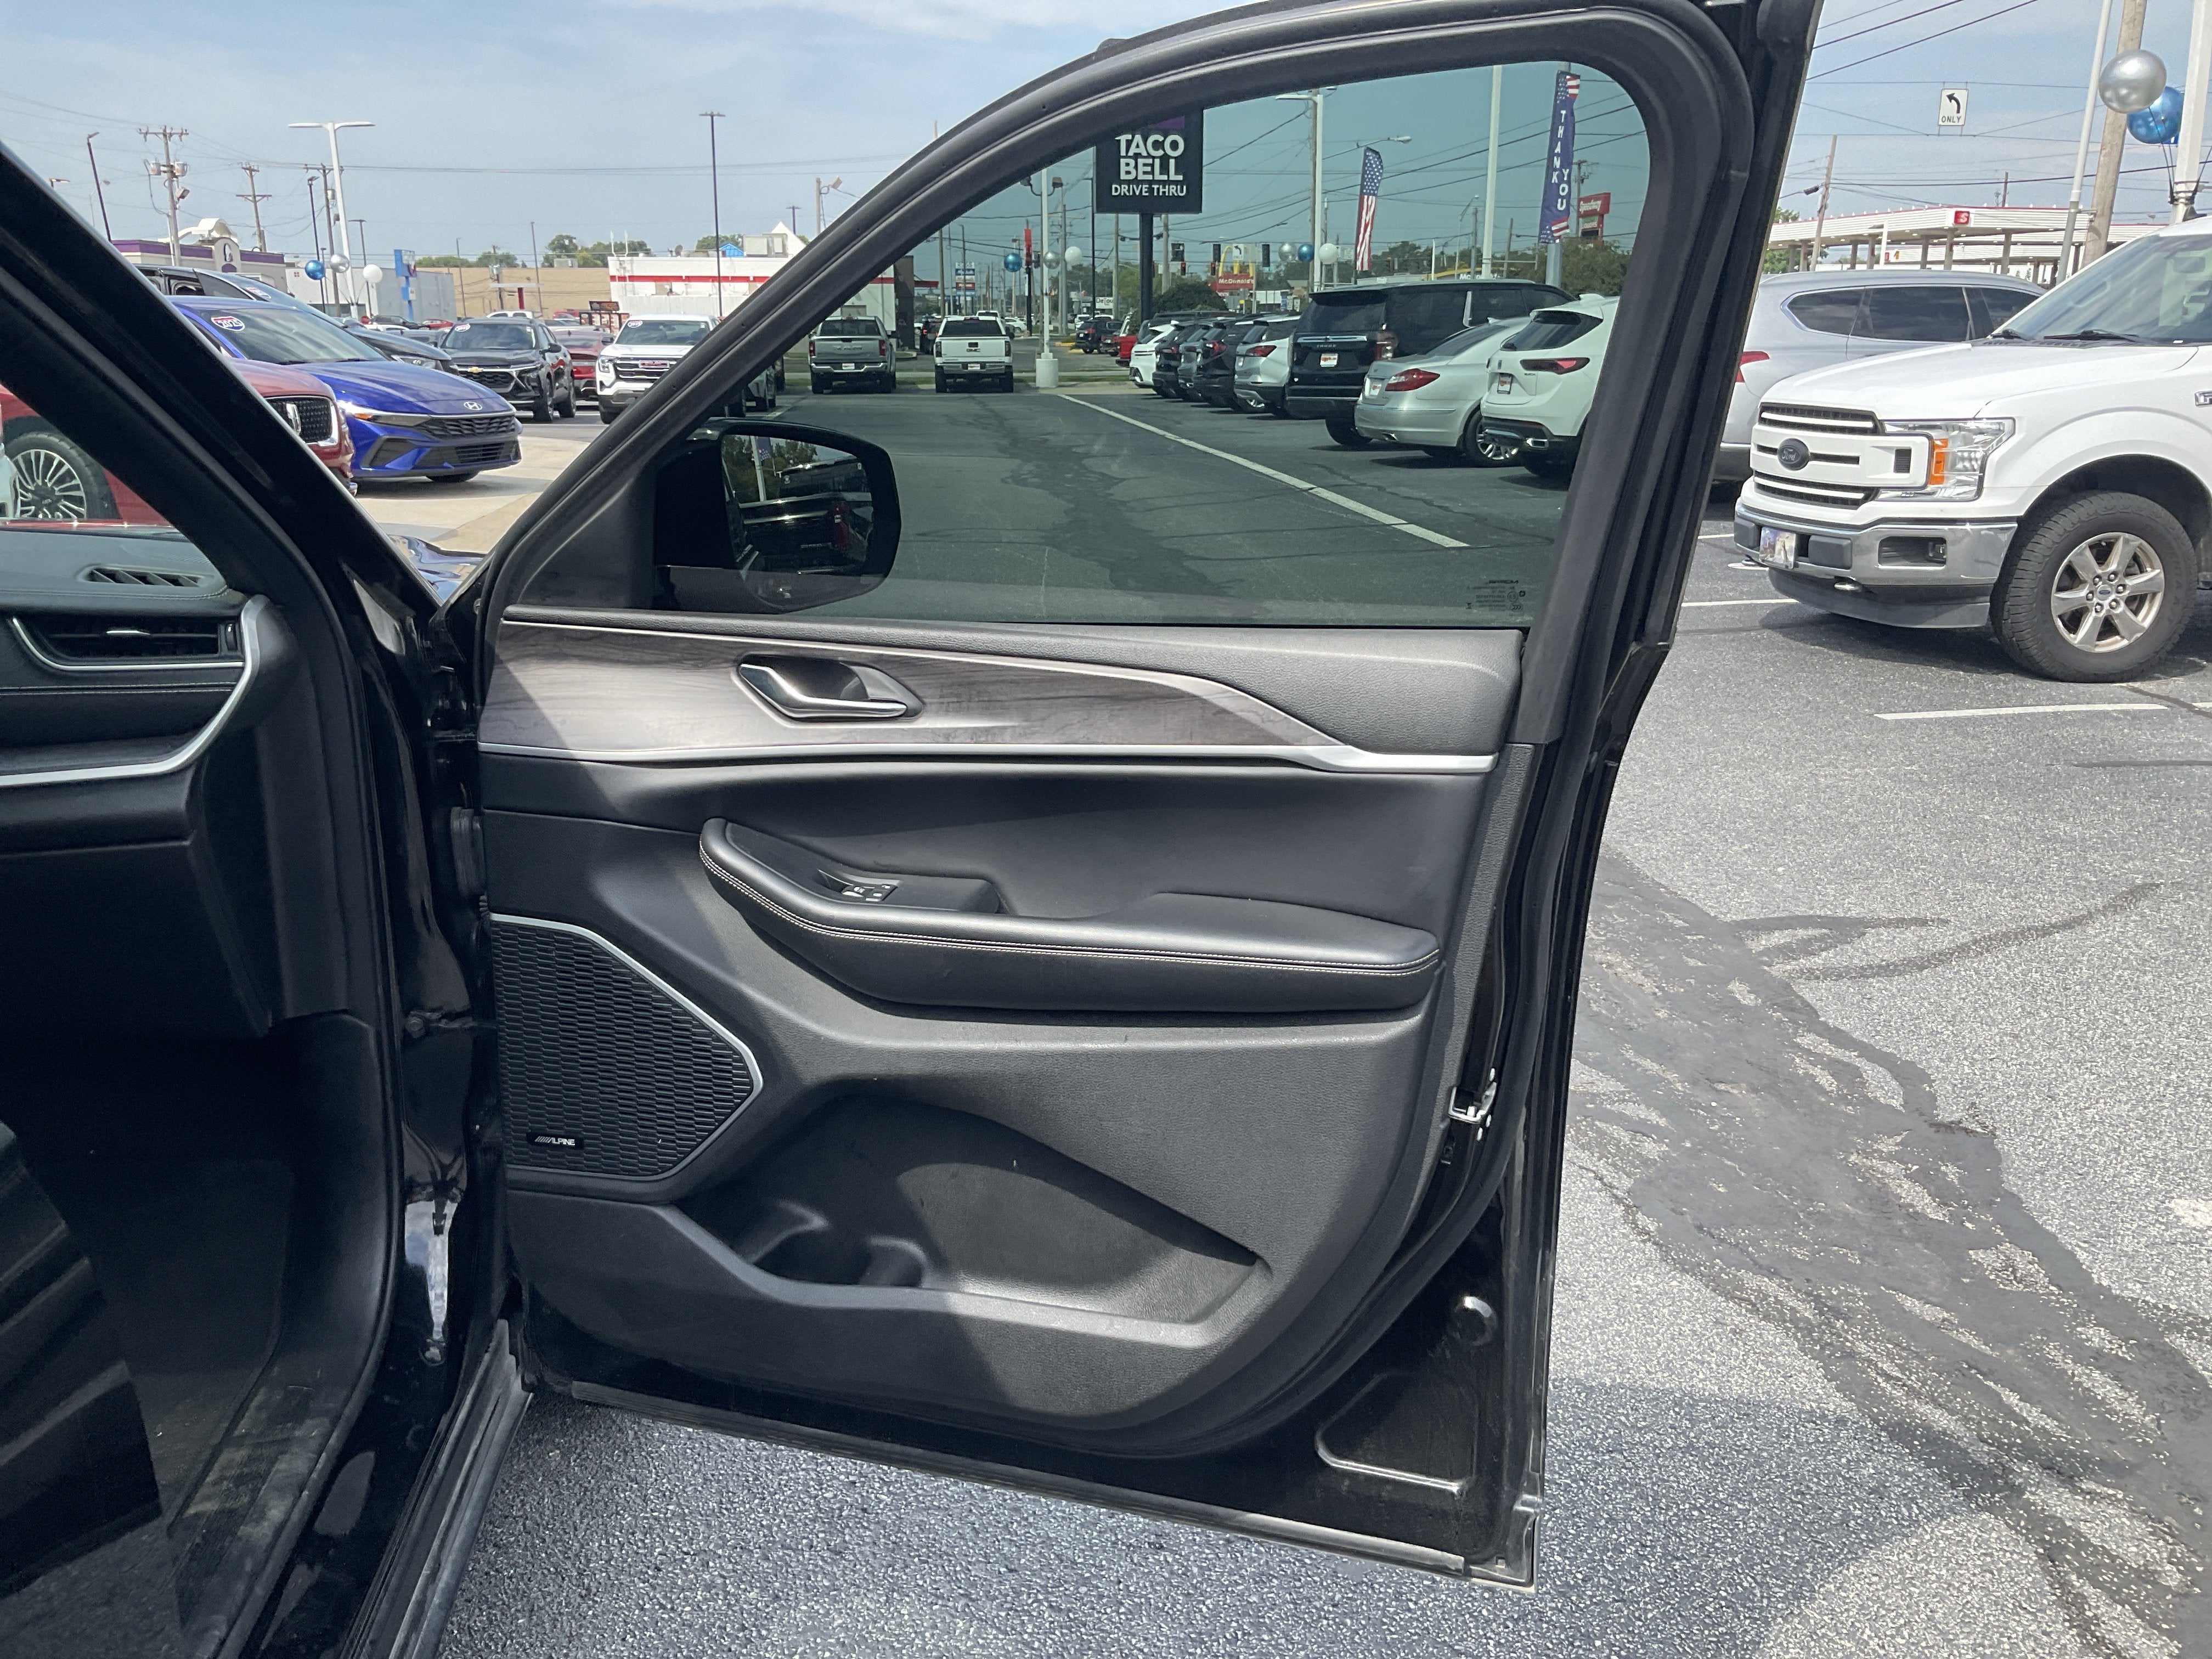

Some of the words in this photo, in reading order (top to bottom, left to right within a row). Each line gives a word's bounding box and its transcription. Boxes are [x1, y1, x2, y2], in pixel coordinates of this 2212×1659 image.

[1115, 134, 1184, 157] TACO
[1551, 110, 1566, 183] THANK
[1120, 158, 1183, 180] BELL
[1111, 184, 1149, 196] DRIVE
[1152, 185, 1187, 196] THRU
[1557, 168, 1570, 211] YOU
[1781, 448, 1797, 461] Ford
[546, 1136, 575, 1146] ALPINE
